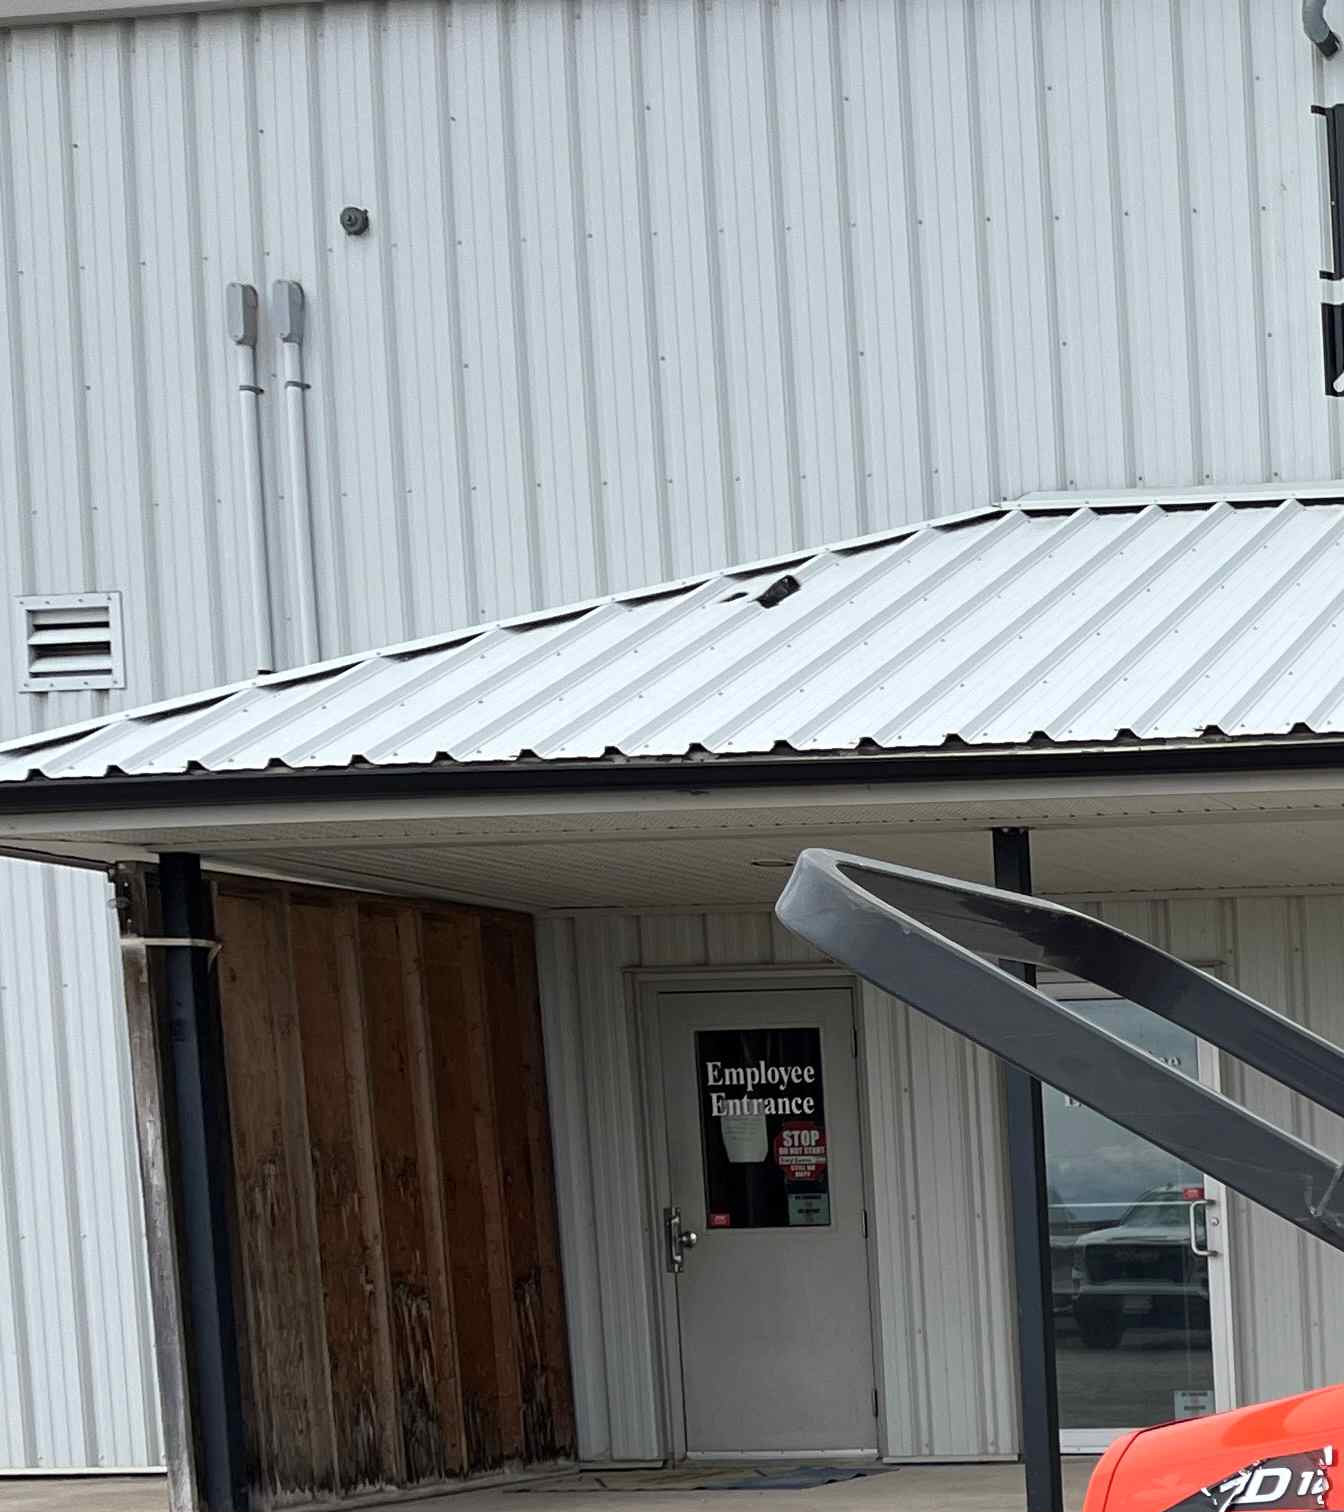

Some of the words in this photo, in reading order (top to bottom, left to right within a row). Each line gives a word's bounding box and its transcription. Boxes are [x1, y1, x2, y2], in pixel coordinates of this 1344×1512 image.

[706, 1060, 815, 1091] Employee
[710, 1092, 815, 1116] Entrance
[783, 1130, 819, 1147] STOP
